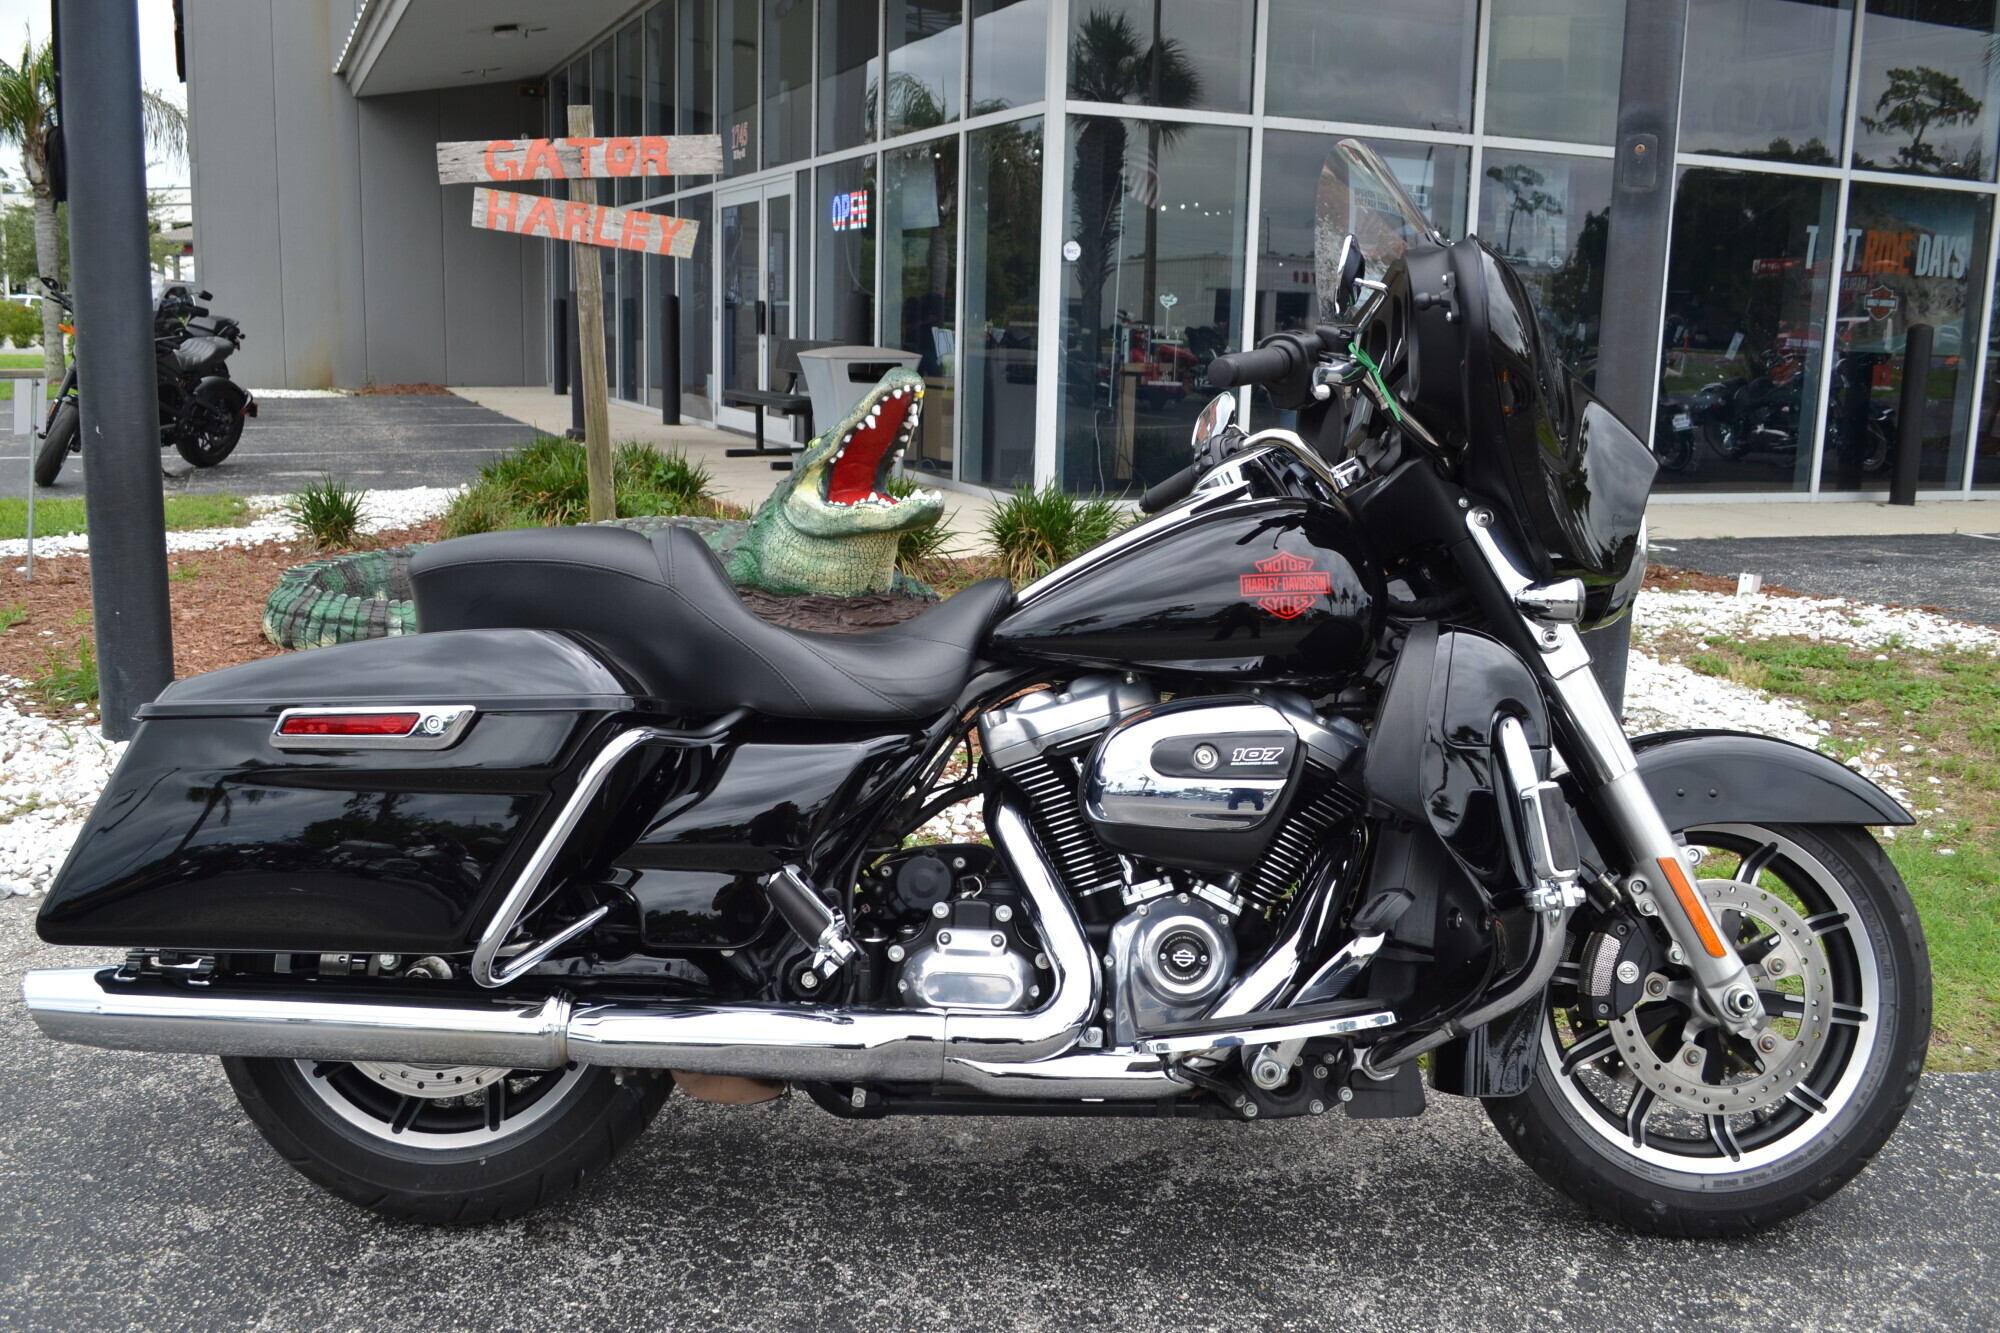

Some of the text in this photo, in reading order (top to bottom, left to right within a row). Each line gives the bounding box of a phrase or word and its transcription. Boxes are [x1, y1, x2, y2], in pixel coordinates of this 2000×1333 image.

[484, 136, 671, 181] GATOR
[485, 189, 685, 255] HARLEY
[832, 190, 867, 231] OPEN
[1862, 230, 1913, 275] RIDE
[1915, 234, 1968, 278] DAYS
[1263, 556, 1307, 572] MOTOR
[1244, 576, 1326, 593] HARLEY-DAVIDSON
[1265, 596, 1309, 615] CYCLES
[1232, 747, 1285, 761] 107
